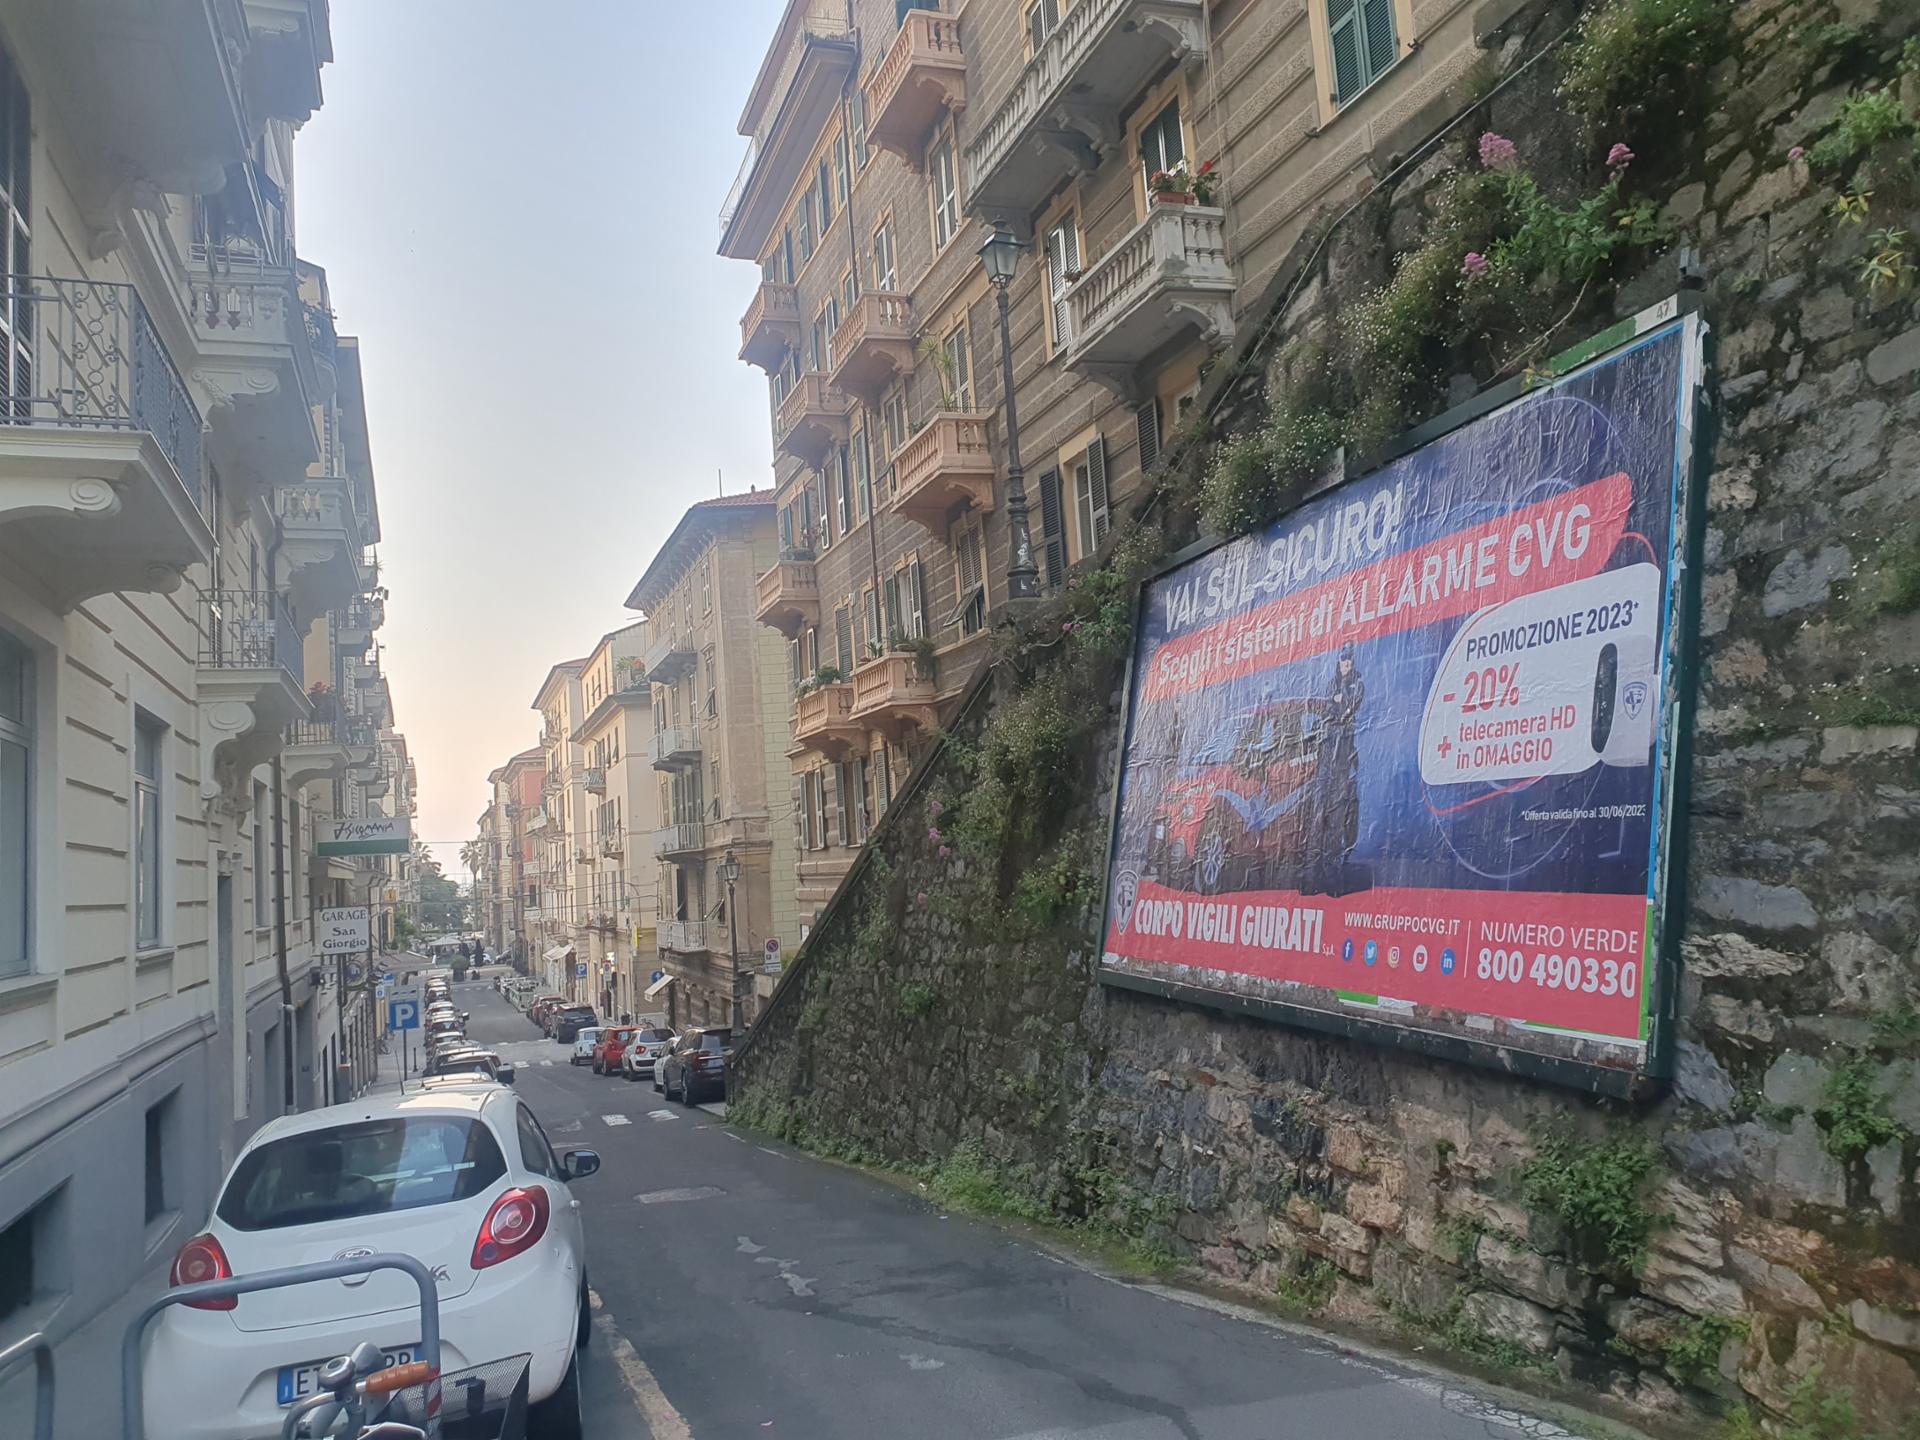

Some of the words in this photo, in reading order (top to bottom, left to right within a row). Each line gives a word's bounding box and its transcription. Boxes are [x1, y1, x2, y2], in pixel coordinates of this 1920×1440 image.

[1657, 302, 1671, 319] 47
[1166, 576, 1202, 632] VAI
[1263, 482, 1403, 594] SICURO!
[1160, 633, 1212, 684] Scegli
[1215, 632, 1223, 665] i
[1223, 609, 1304, 665] sistemi
[1310, 591, 1335, 638] di
[1337, 534, 1499, 630] ALLARME
[1508, 503, 1590, 577] CVG
[1466, 611, 1583, 662] PROMOZIONE
[1459, 714, 1546, 743] telecamera
[1550, 704, 1576, 731] HD
[1456, 748, 1470, 770] in
[1473, 738, 1553, 767] OMAGGIO
[1550, 808, 1573, 820] valida
[1573, 807, 1588, 820] fino
[1589, 809, 1597, 819] al
[322, 909, 367, 922] GARAGE
[332, 926, 357, 937] San
[1134, 898, 1184, 939] CORPO
[1187, 901, 1238, 944] VIGILI
[1240, 906, 1324, 954] GIURATI
[1344, 911, 1461, 936] WWW.GRUPPOCVG.IT
[322, 938, 367, 949] Giorgio
[1480, 921, 1565, 947] NUMERO
[1571, 927, 1639, 954] VERDE
[1477, 948, 1524, 983] 800
[1529, 954, 1636, 998] 490330
[395, 1003, 415, 1028] P
